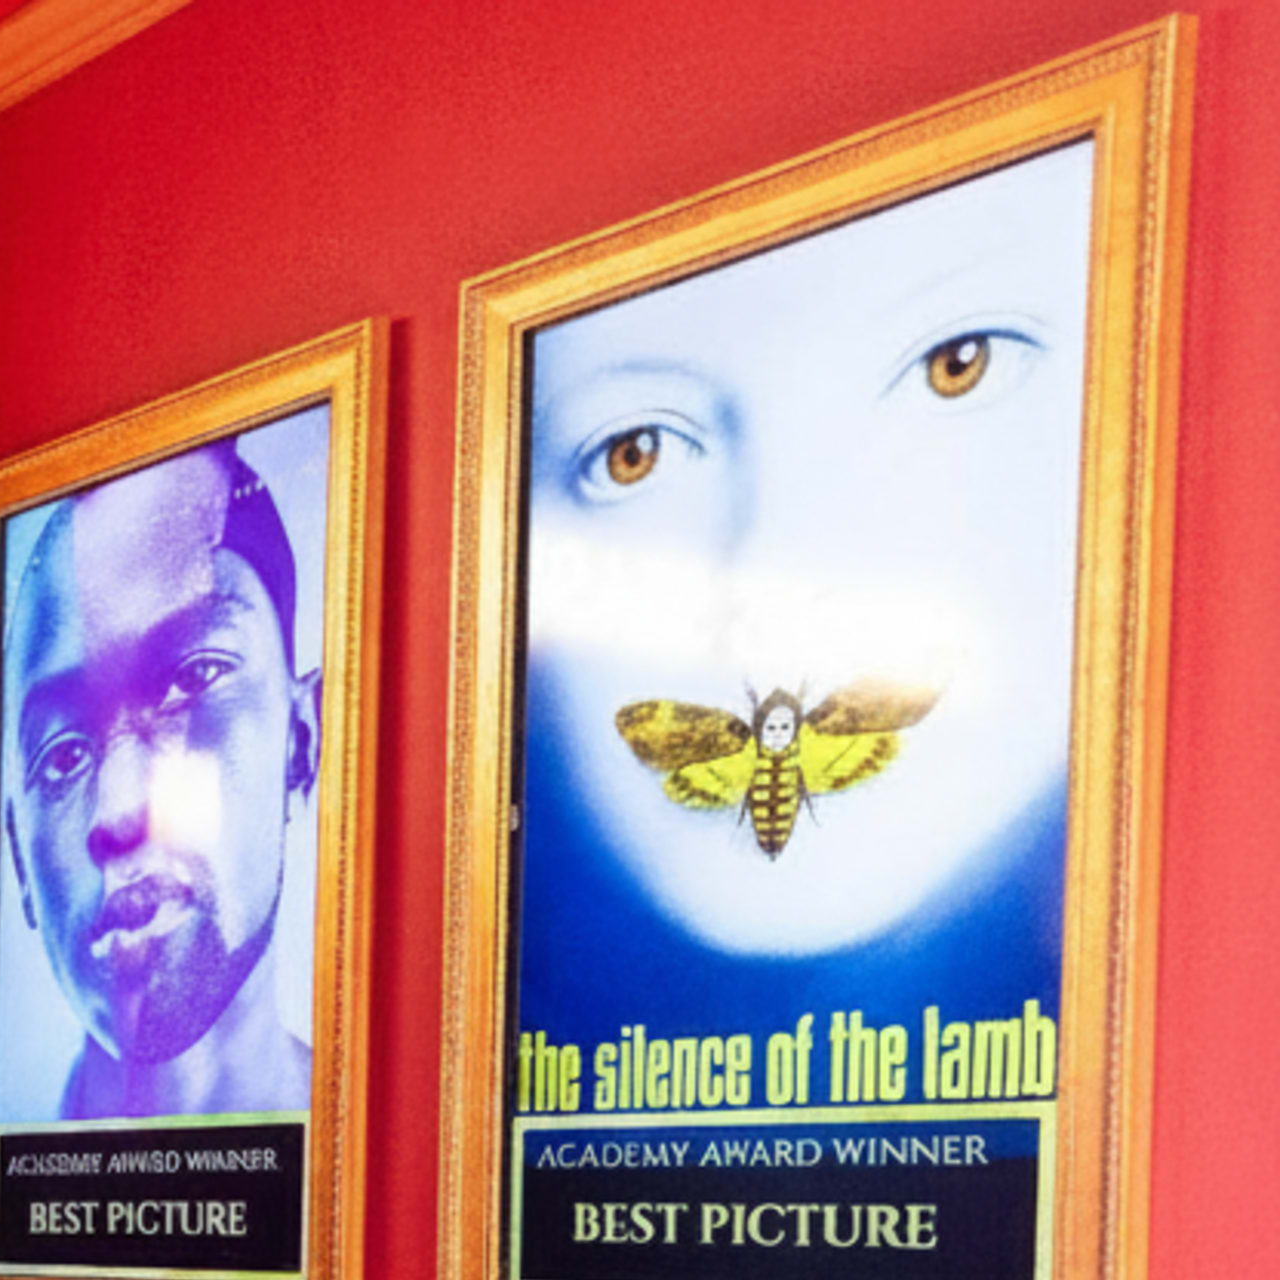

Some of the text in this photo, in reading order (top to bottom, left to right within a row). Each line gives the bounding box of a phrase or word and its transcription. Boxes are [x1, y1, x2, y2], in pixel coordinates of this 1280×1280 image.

[518, 1031, 580, 1111] the
[594, 1024, 751, 1111] silence
[766, 1013, 814, 1105] of
[830, 1010, 907, 1102] the
[537, 1134, 989, 1169] ACADEMY AWARD WINNER
[29, 1200, 248, 1236] BEST PICTURE
[573, 1202, 938, 1250] BEST PICTURE
